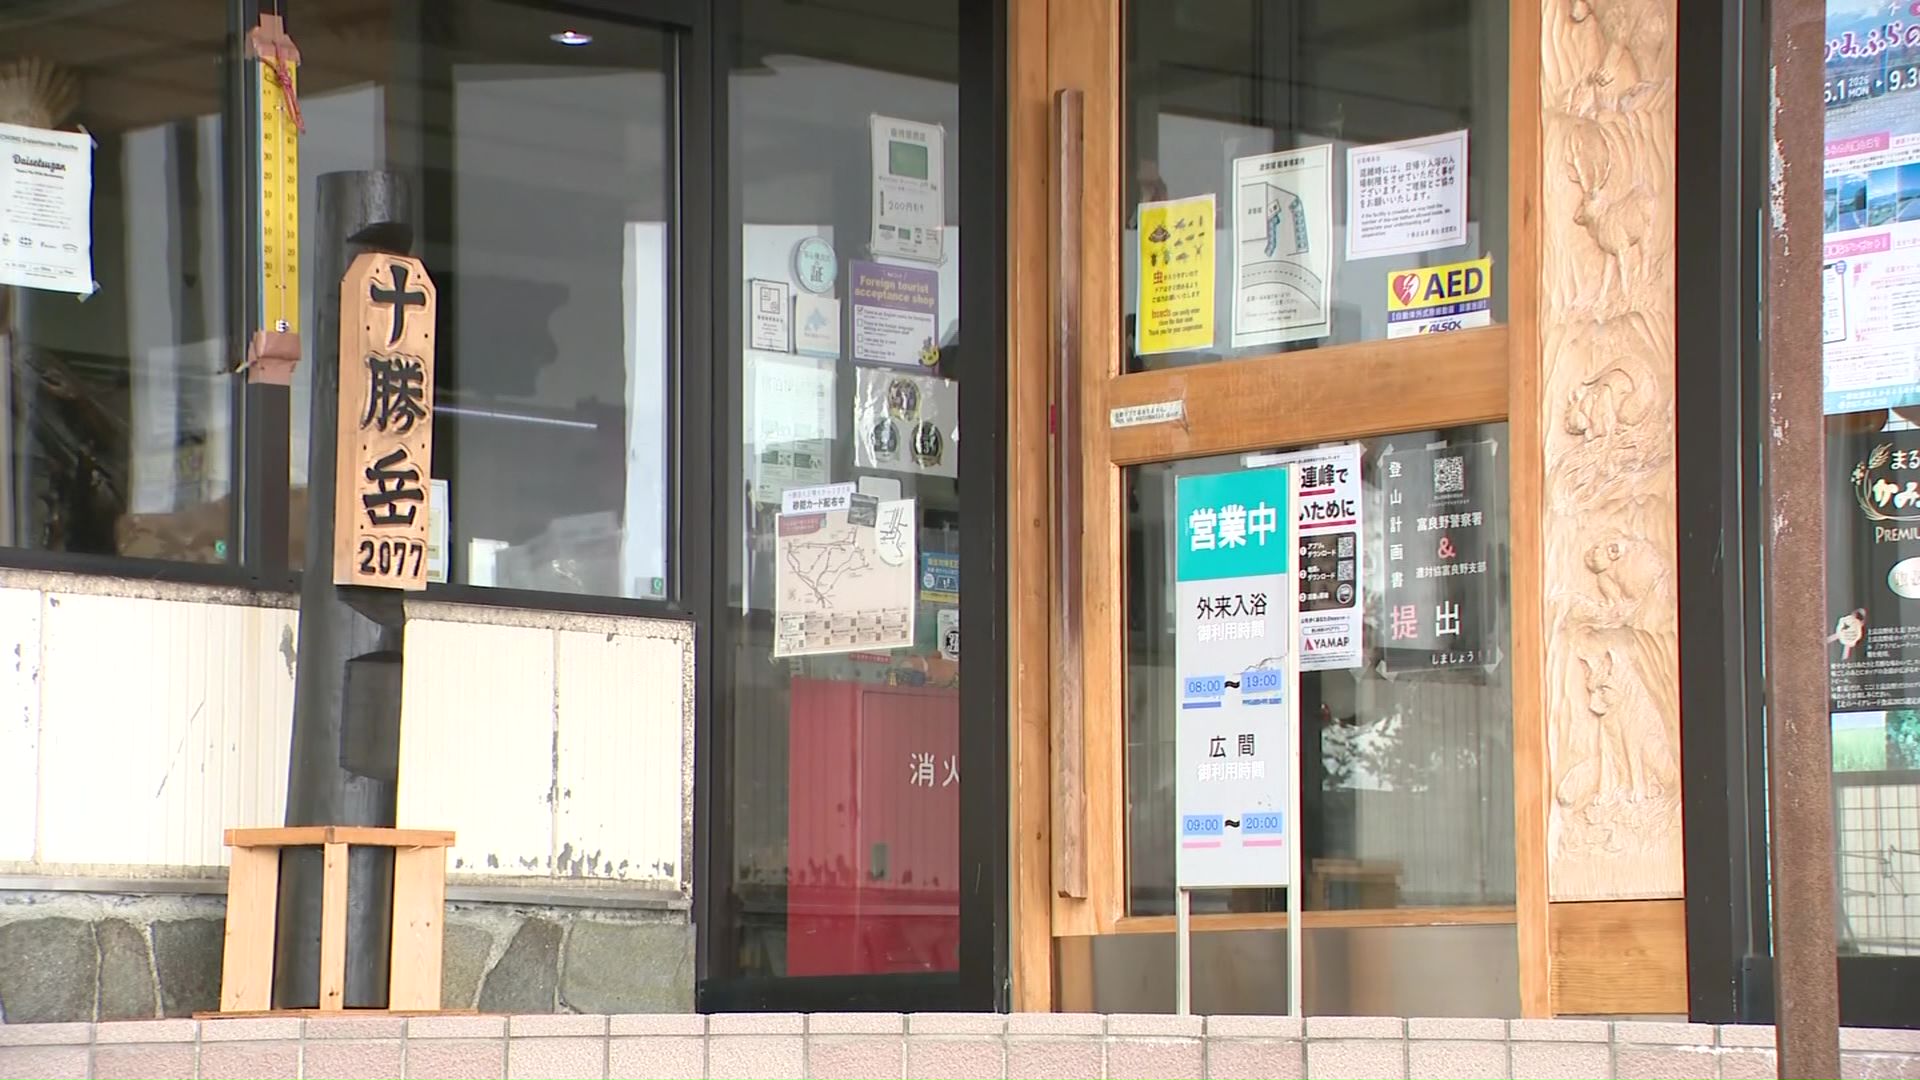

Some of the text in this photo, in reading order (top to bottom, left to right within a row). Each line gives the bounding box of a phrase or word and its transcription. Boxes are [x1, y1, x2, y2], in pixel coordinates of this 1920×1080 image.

[1889, 67, 1920, 91] 9.3
[1848, 87, 1870, 98] MON
[860, 275, 896, 290] Foreign
[898, 281, 929, 294] tourist
[1424, 267, 1483, 300] AED
[854, 288, 935, 308] acceptance shop
[361, 264, 427, 527] 十勝岳
[1301, 463, 1349, 489] 連峰で
[1872, 478, 1920, 509] かみ
[1188, 501, 1277, 552] 営業中
[1388, 461, 1403, 589] 登山計画書
[1416, 512, 1483, 532] 富良野警察署
[359, 539, 423, 578] 2077
[1437, 537, 1456, 559] &
[1197, 593, 1268, 621] 外来入浴
[1197, 620, 1266, 644] 御利用時間
[1314, 636, 1350, 649] YAMAP
[1188, 679, 1221, 693] 08:00
[1246, 674, 1278, 688] 19:00
[910, 752, 960, 787] 消火
[1198, 760, 1266, 783] 御利用時間
[1186, 818, 1219, 832] 09:00
[1246, 816, 1278, 831] 20:00
